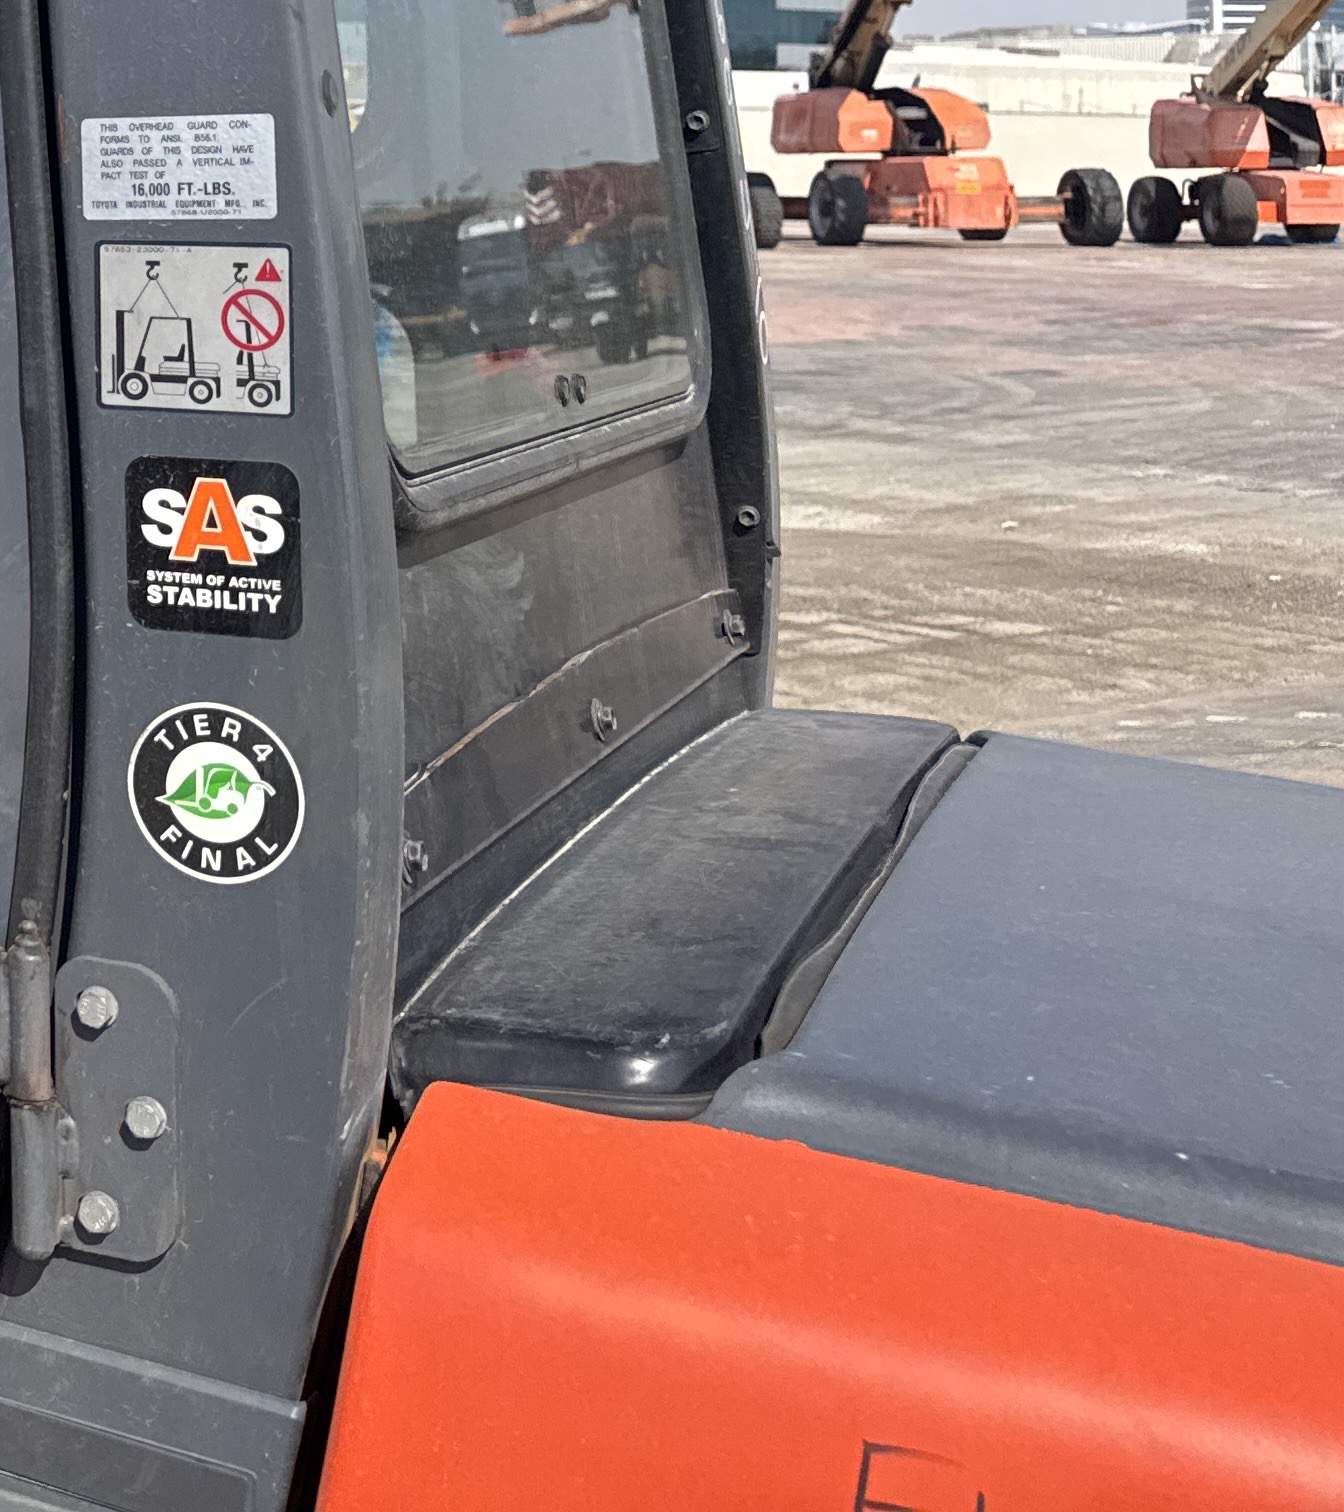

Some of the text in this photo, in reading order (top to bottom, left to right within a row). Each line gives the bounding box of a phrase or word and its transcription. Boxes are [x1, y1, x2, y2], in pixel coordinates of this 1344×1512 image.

[100, 120, 252, 133] THIS OVERHEAD GUARD CON-
[100, 135, 130, 144] FORMS
[138, 135, 150, 144] TO
[100, 144, 254, 156] GUARDS OF THIS DESIGN HAVE
[100, 159, 123, 168] ALSO
[133, 158, 167, 168] PASSED
[176, 158, 183, 167] A
[192, 157, 235, 167] VERTICAL
[100, 170, 166, 180] PACT TEST OF
[131, 183, 171, 198] 16,000
[91, 200, 118, 209] TOYOTA
[125, 199, 167, 209] INDUSTRIAL
[175, 199, 216, 208] EQUIPMENT
[141, 477, 285, 566] SAS
[146, 569, 281, 591] SYSTEM OF ACTIVE
[146, 585, 282, 614] STABILITY
[153, 713, 274, 763] TIER 4
[159, 824, 279, 872] FINAL
